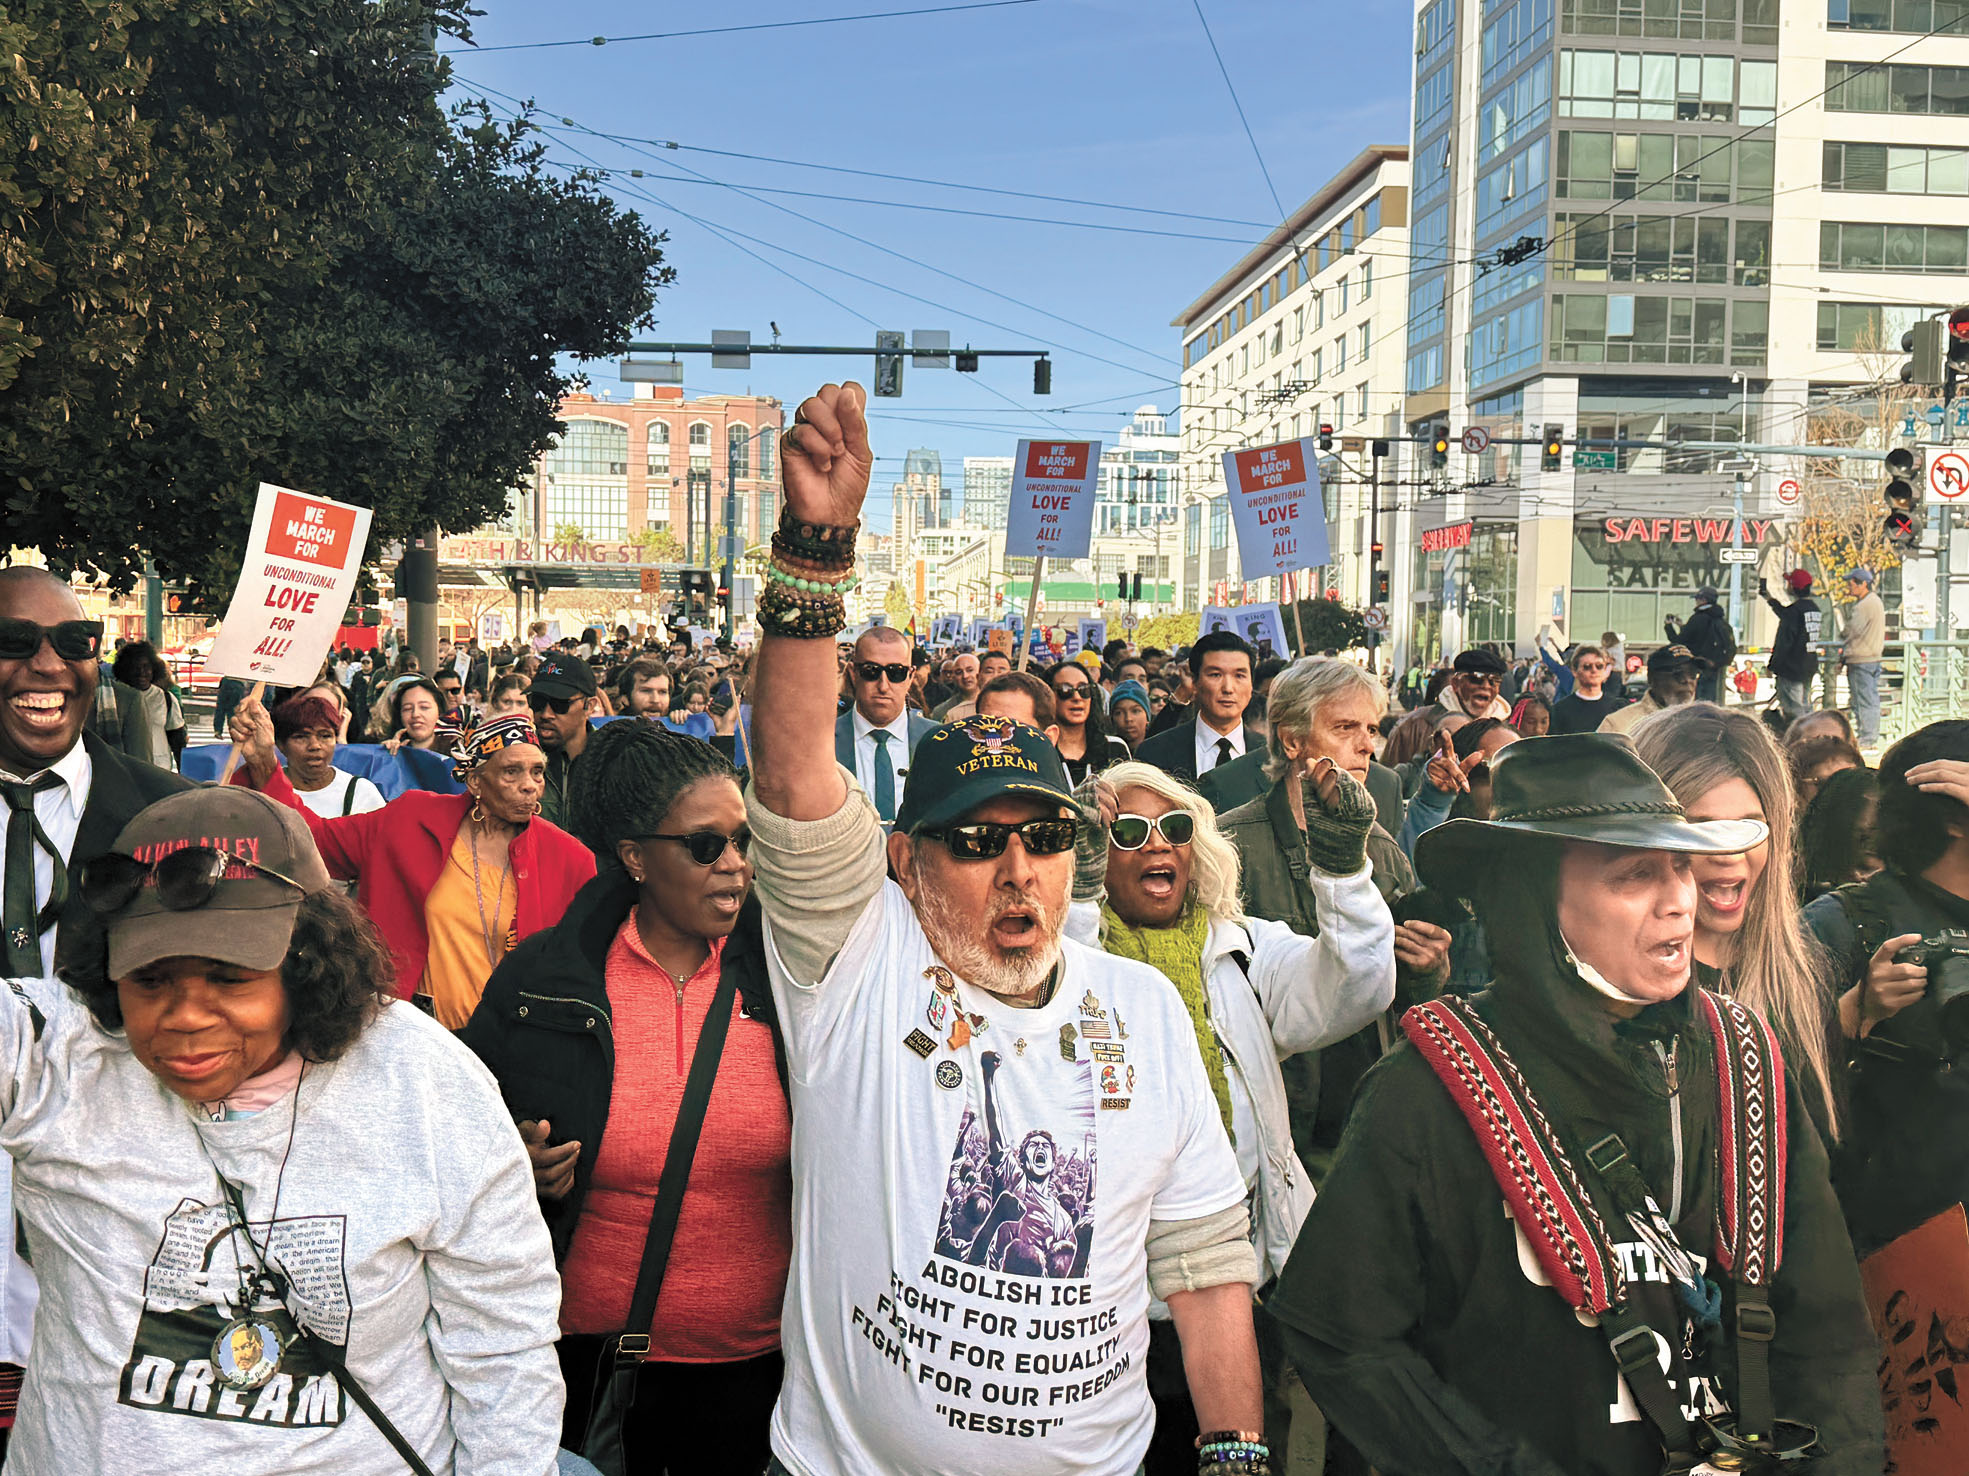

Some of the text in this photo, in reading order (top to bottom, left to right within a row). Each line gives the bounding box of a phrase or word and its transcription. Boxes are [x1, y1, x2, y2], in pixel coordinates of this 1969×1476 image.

[1051, 445, 1066, 456] WE
[1260, 450, 1277, 463] WE
[1038, 456, 1076, 467] MARCH
[1046, 467, 1064, 476] FOR
[1251, 459, 1291, 477] MARCH
[1026, 483, 1082, 493] UNCONDITIONAL
[1263, 473, 1282, 487] FOR
[1032, 495, 1071, 510] LOVE
[1247, 488, 1306, 508] UNCONDITIONAL
[304, 505, 326, 524] WE
[1041, 514, 1058, 523] FOR
[1258, 503, 1299, 526] LOVE
[286, 520, 336, 545] MARCH
[1036, 527, 1062, 541] ALL!
[1273, 526, 1291, 538] FOR
[1605, 518, 1771, 543] SAFEWAY
[294, 543, 319, 558] FOR
[517, 542, 533, 560] &
[545, 543, 607, 562] KING
[618, 545, 646, 562] ST
[1273, 538, 1297, 558] ALL!
[264, 564, 337, 589] UNCONDITIONAL
[264, 584, 320, 613] LOVE
[270, 617, 295, 631] FOR
[1244, 613, 1266, 622] KING
[254, 636, 292, 658] ALL!
[956, 754, 1038, 776] VETERAN
[910, 1030, 936, 1051] FIGHT
[1101, 1098, 1131, 1109] RESIST
[922, 1260, 1091, 1306] ABOLISH ICE
[890, 1270, 1117, 1341] FIGHT FOR JUSTICE
[877, 1293, 1121, 1375] FIGHT FOR EQUALITY
[851, 1305, 1130, 1406] FIGHT FOR OUR FREEDOM
[130, 1354, 339, 1424] DREAM
[936, 1404, 1063, 1438] "RESIST"
